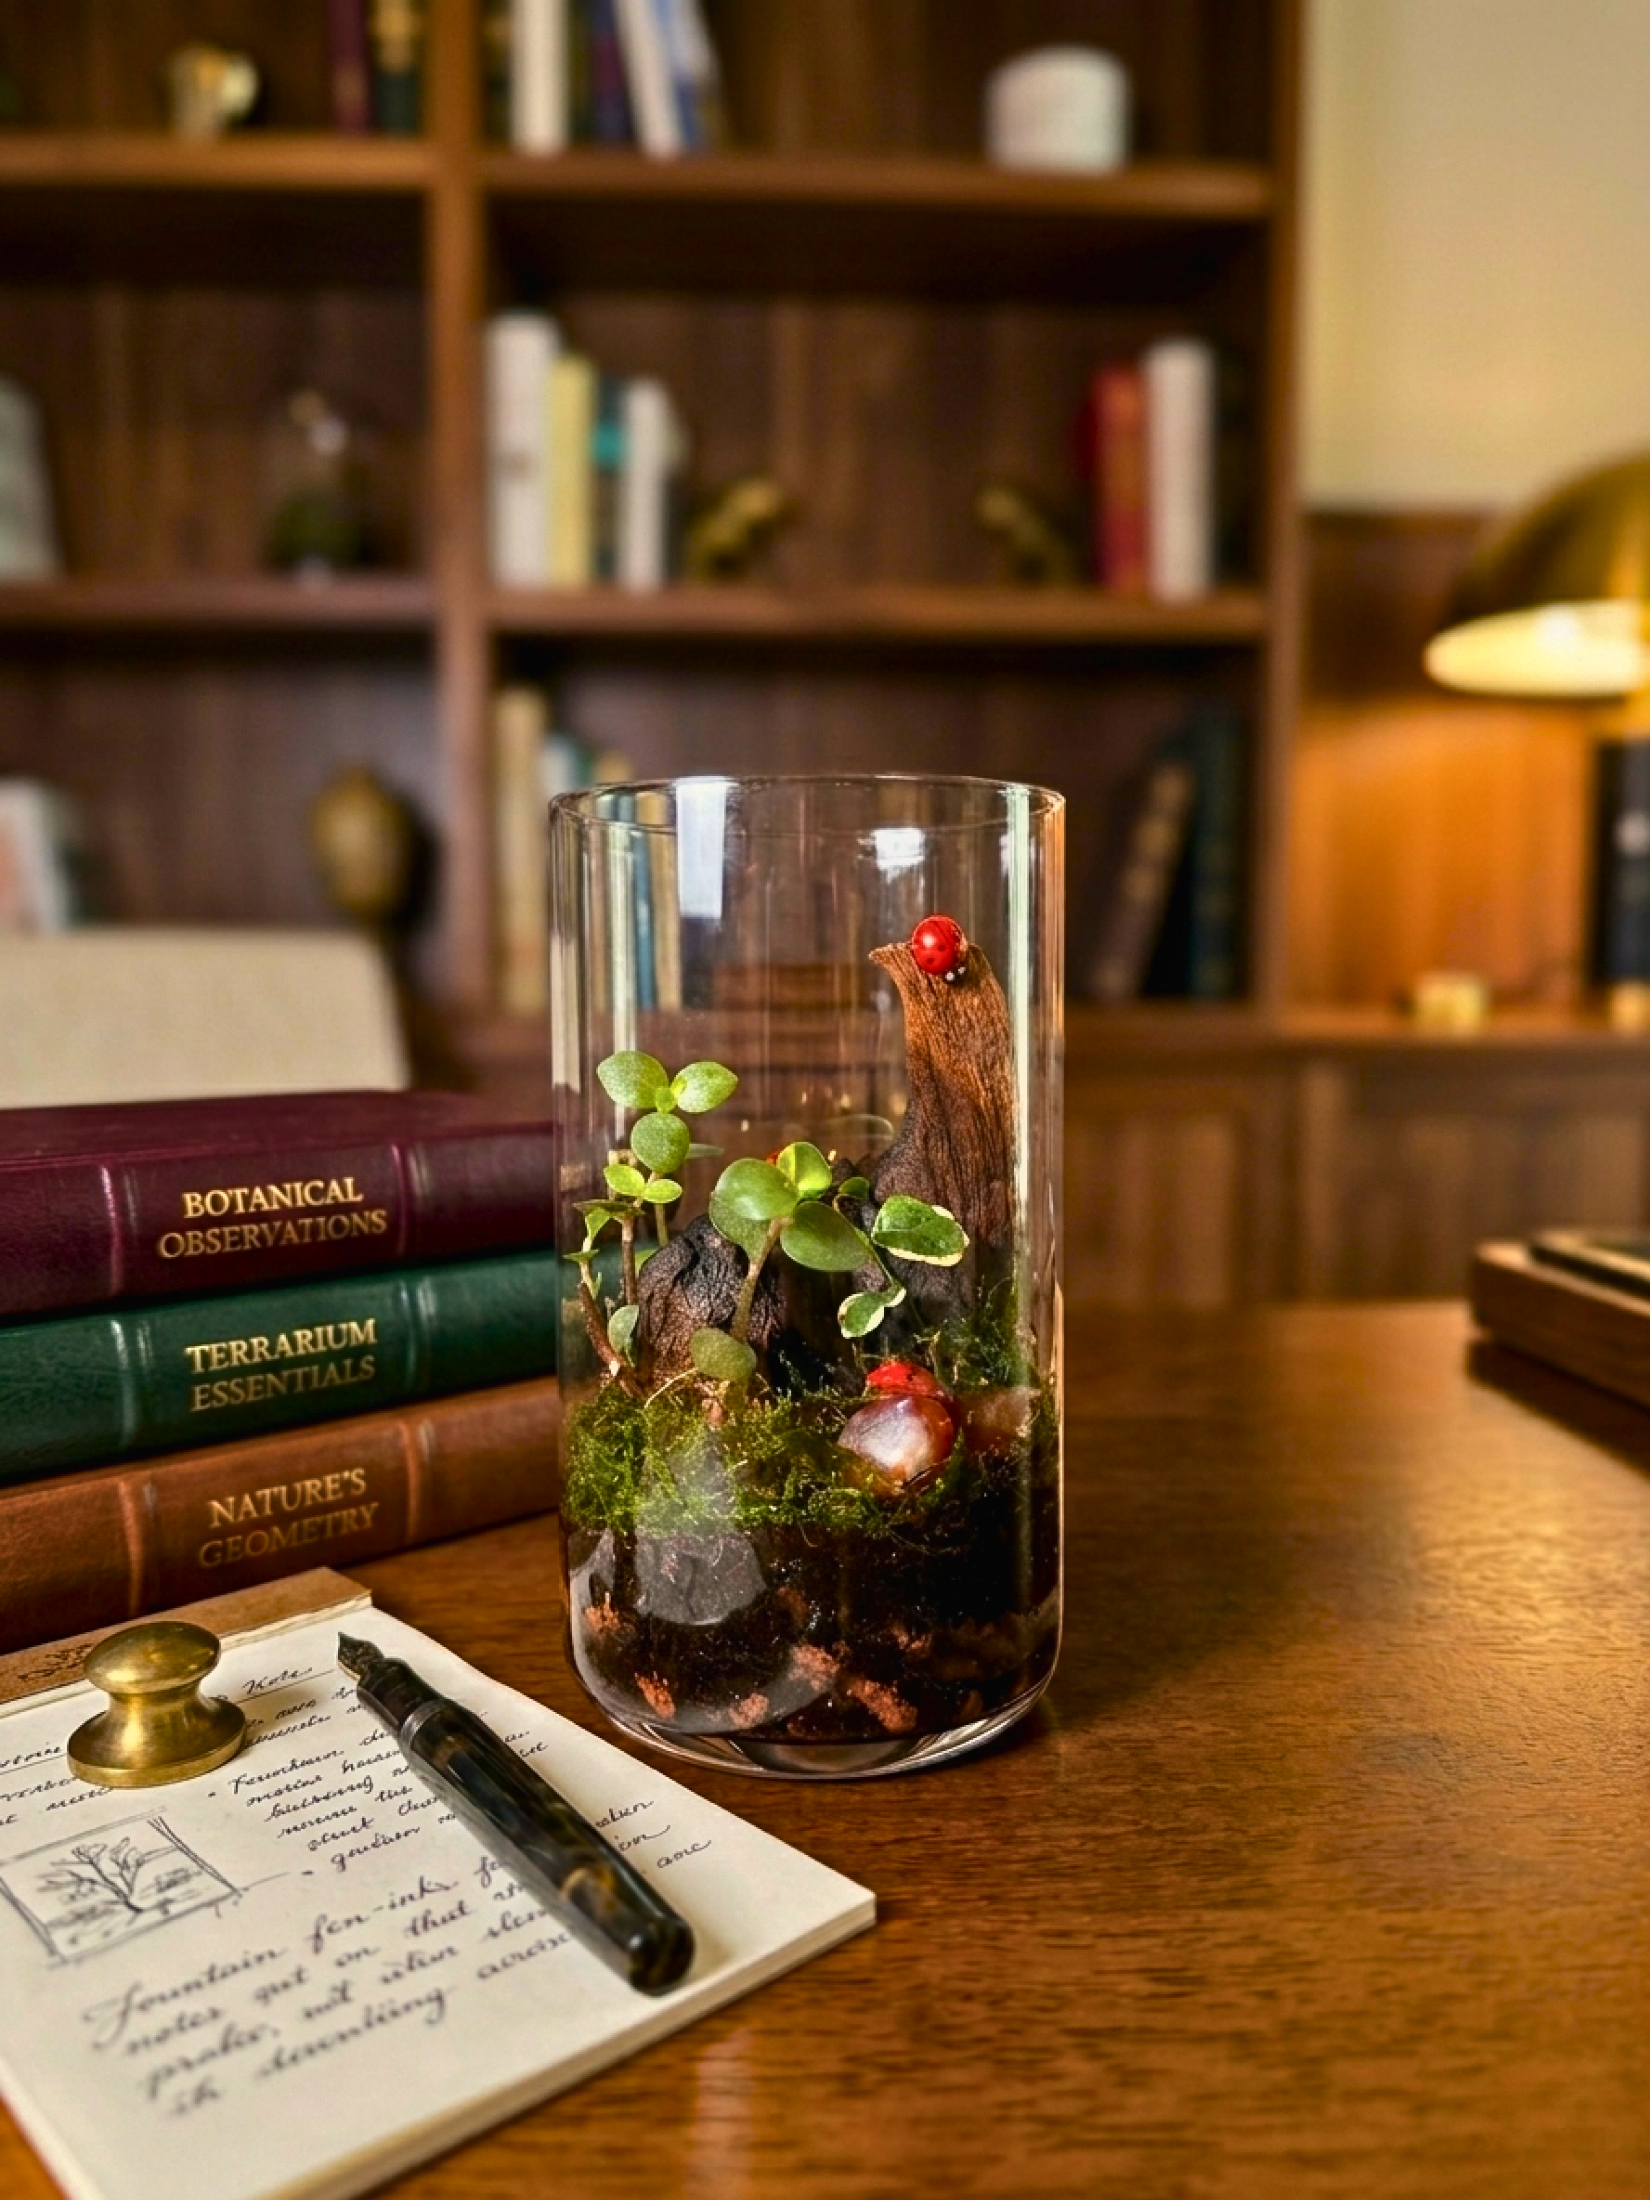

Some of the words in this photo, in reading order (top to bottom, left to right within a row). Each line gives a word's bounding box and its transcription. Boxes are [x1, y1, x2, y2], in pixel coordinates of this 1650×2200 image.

[182, 1176, 364, 1219] BOTANICAL
[157, 1209, 388, 1260] OBSERVATIONS
[184, 1317, 378, 1374] TERRARIUM
[189, 1355, 376, 1412] ESSENTIALS
[207, 1467, 367, 1529] NATURE'S
[199, 1501, 380, 1573] GEOMETRY
